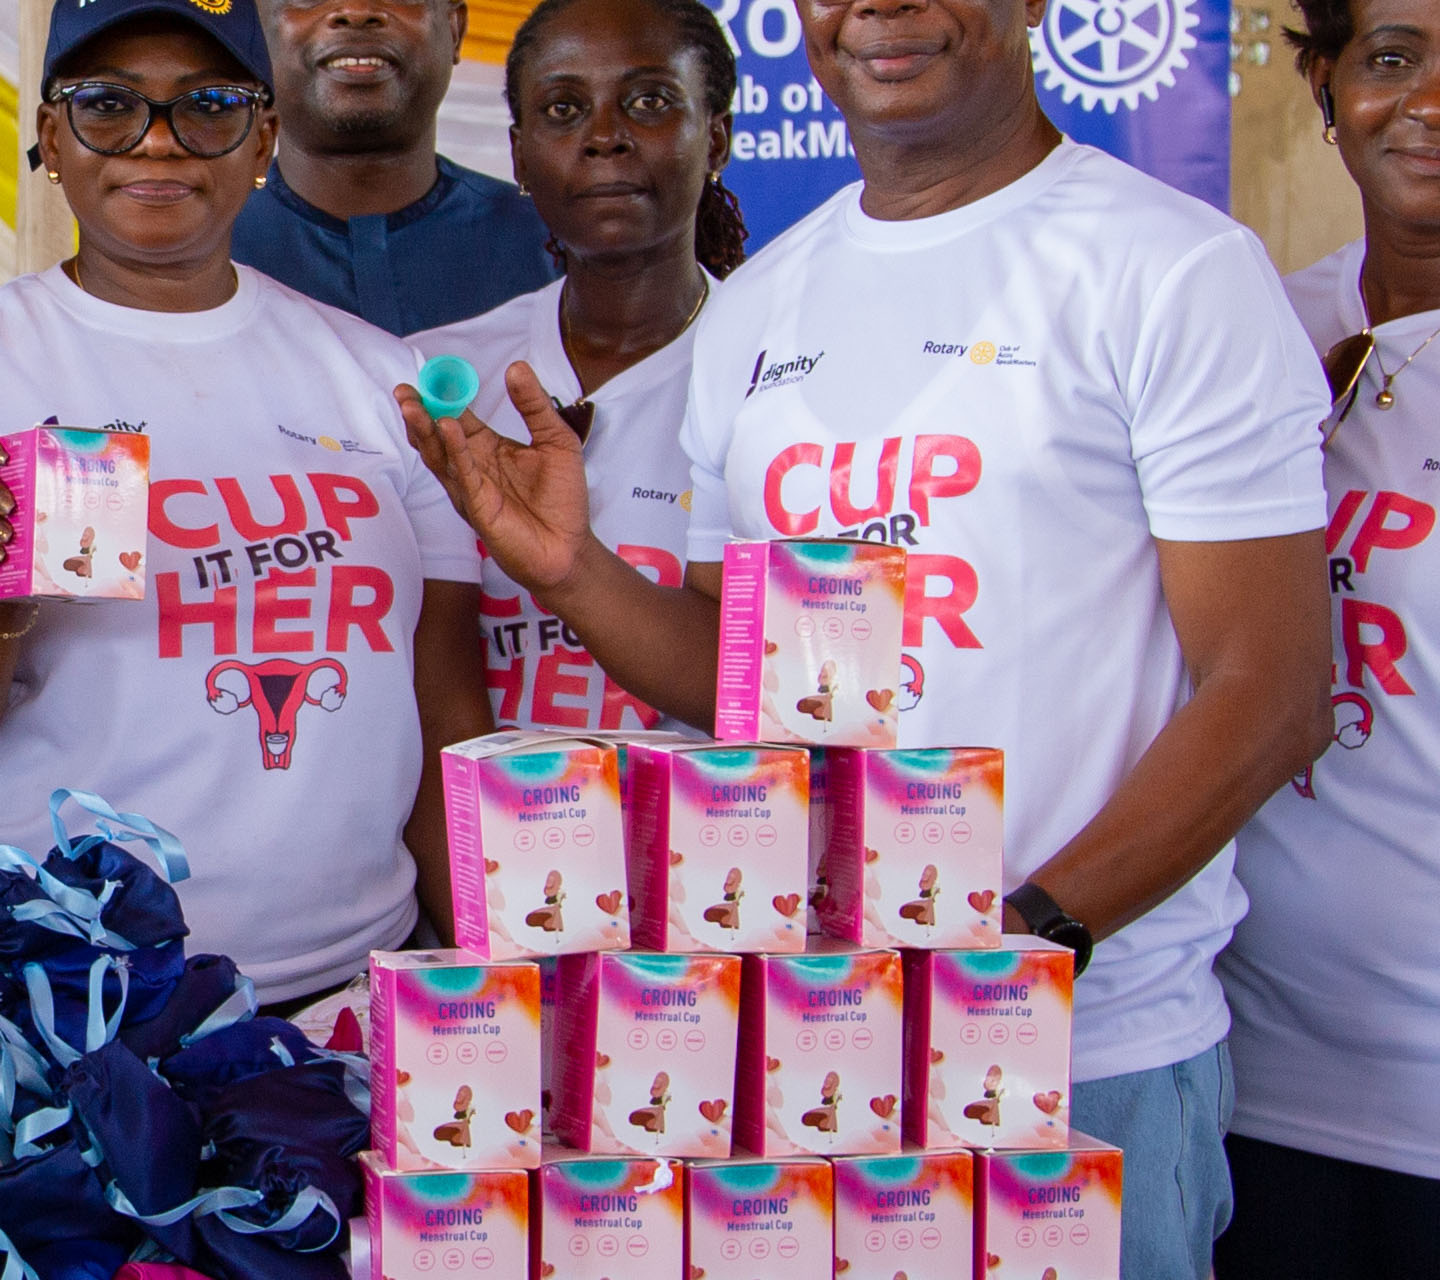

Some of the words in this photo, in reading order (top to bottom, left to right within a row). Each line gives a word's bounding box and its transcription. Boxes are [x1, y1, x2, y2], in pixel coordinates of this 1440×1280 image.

[923, 341, 968, 356] Rotary
[764, 434, 982, 536] CUP
[632, 487, 678, 504] Rotary
[149, 473, 381, 549] CUP
[194, 549, 234, 589] IT
[245, 530, 343, 578] FOR
[808, 576, 863, 596] CROING
[154, 565, 396, 659] HER
[802, 599, 848, 611] Menstrual
[850, 600, 867, 613] Cup
[493, 622, 528, 657] IT
[539, 619, 583, 650] FO
[522, 785, 581, 807] CROING
[906, 782, 962, 800] CROING
[518, 808, 567, 823] Menstrual
[568, 806, 587, 821] Cup
[901, 805, 946, 816] Menstrual
[948, 804, 966, 817] Cup
[641, 989, 697, 1007] CROING
[634, 1010, 682, 1023] Menstrual
[684, 1011, 701, 1025] Cup
[1028, 1187, 1081, 1205] CROING
[732, 1198, 789, 1216] CROING
[1022, 1208, 1067, 1220] Menstrual
[1068, 1207, 1086, 1220] Cup
[425, 1208, 483, 1227] CROING
[727, 1220, 774, 1233] Menstrual
[775, 1219, 794, 1232] Cup
[420, 1231, 469, 1244] Menstrual
[470, 1230, 488, 1244] Cup
